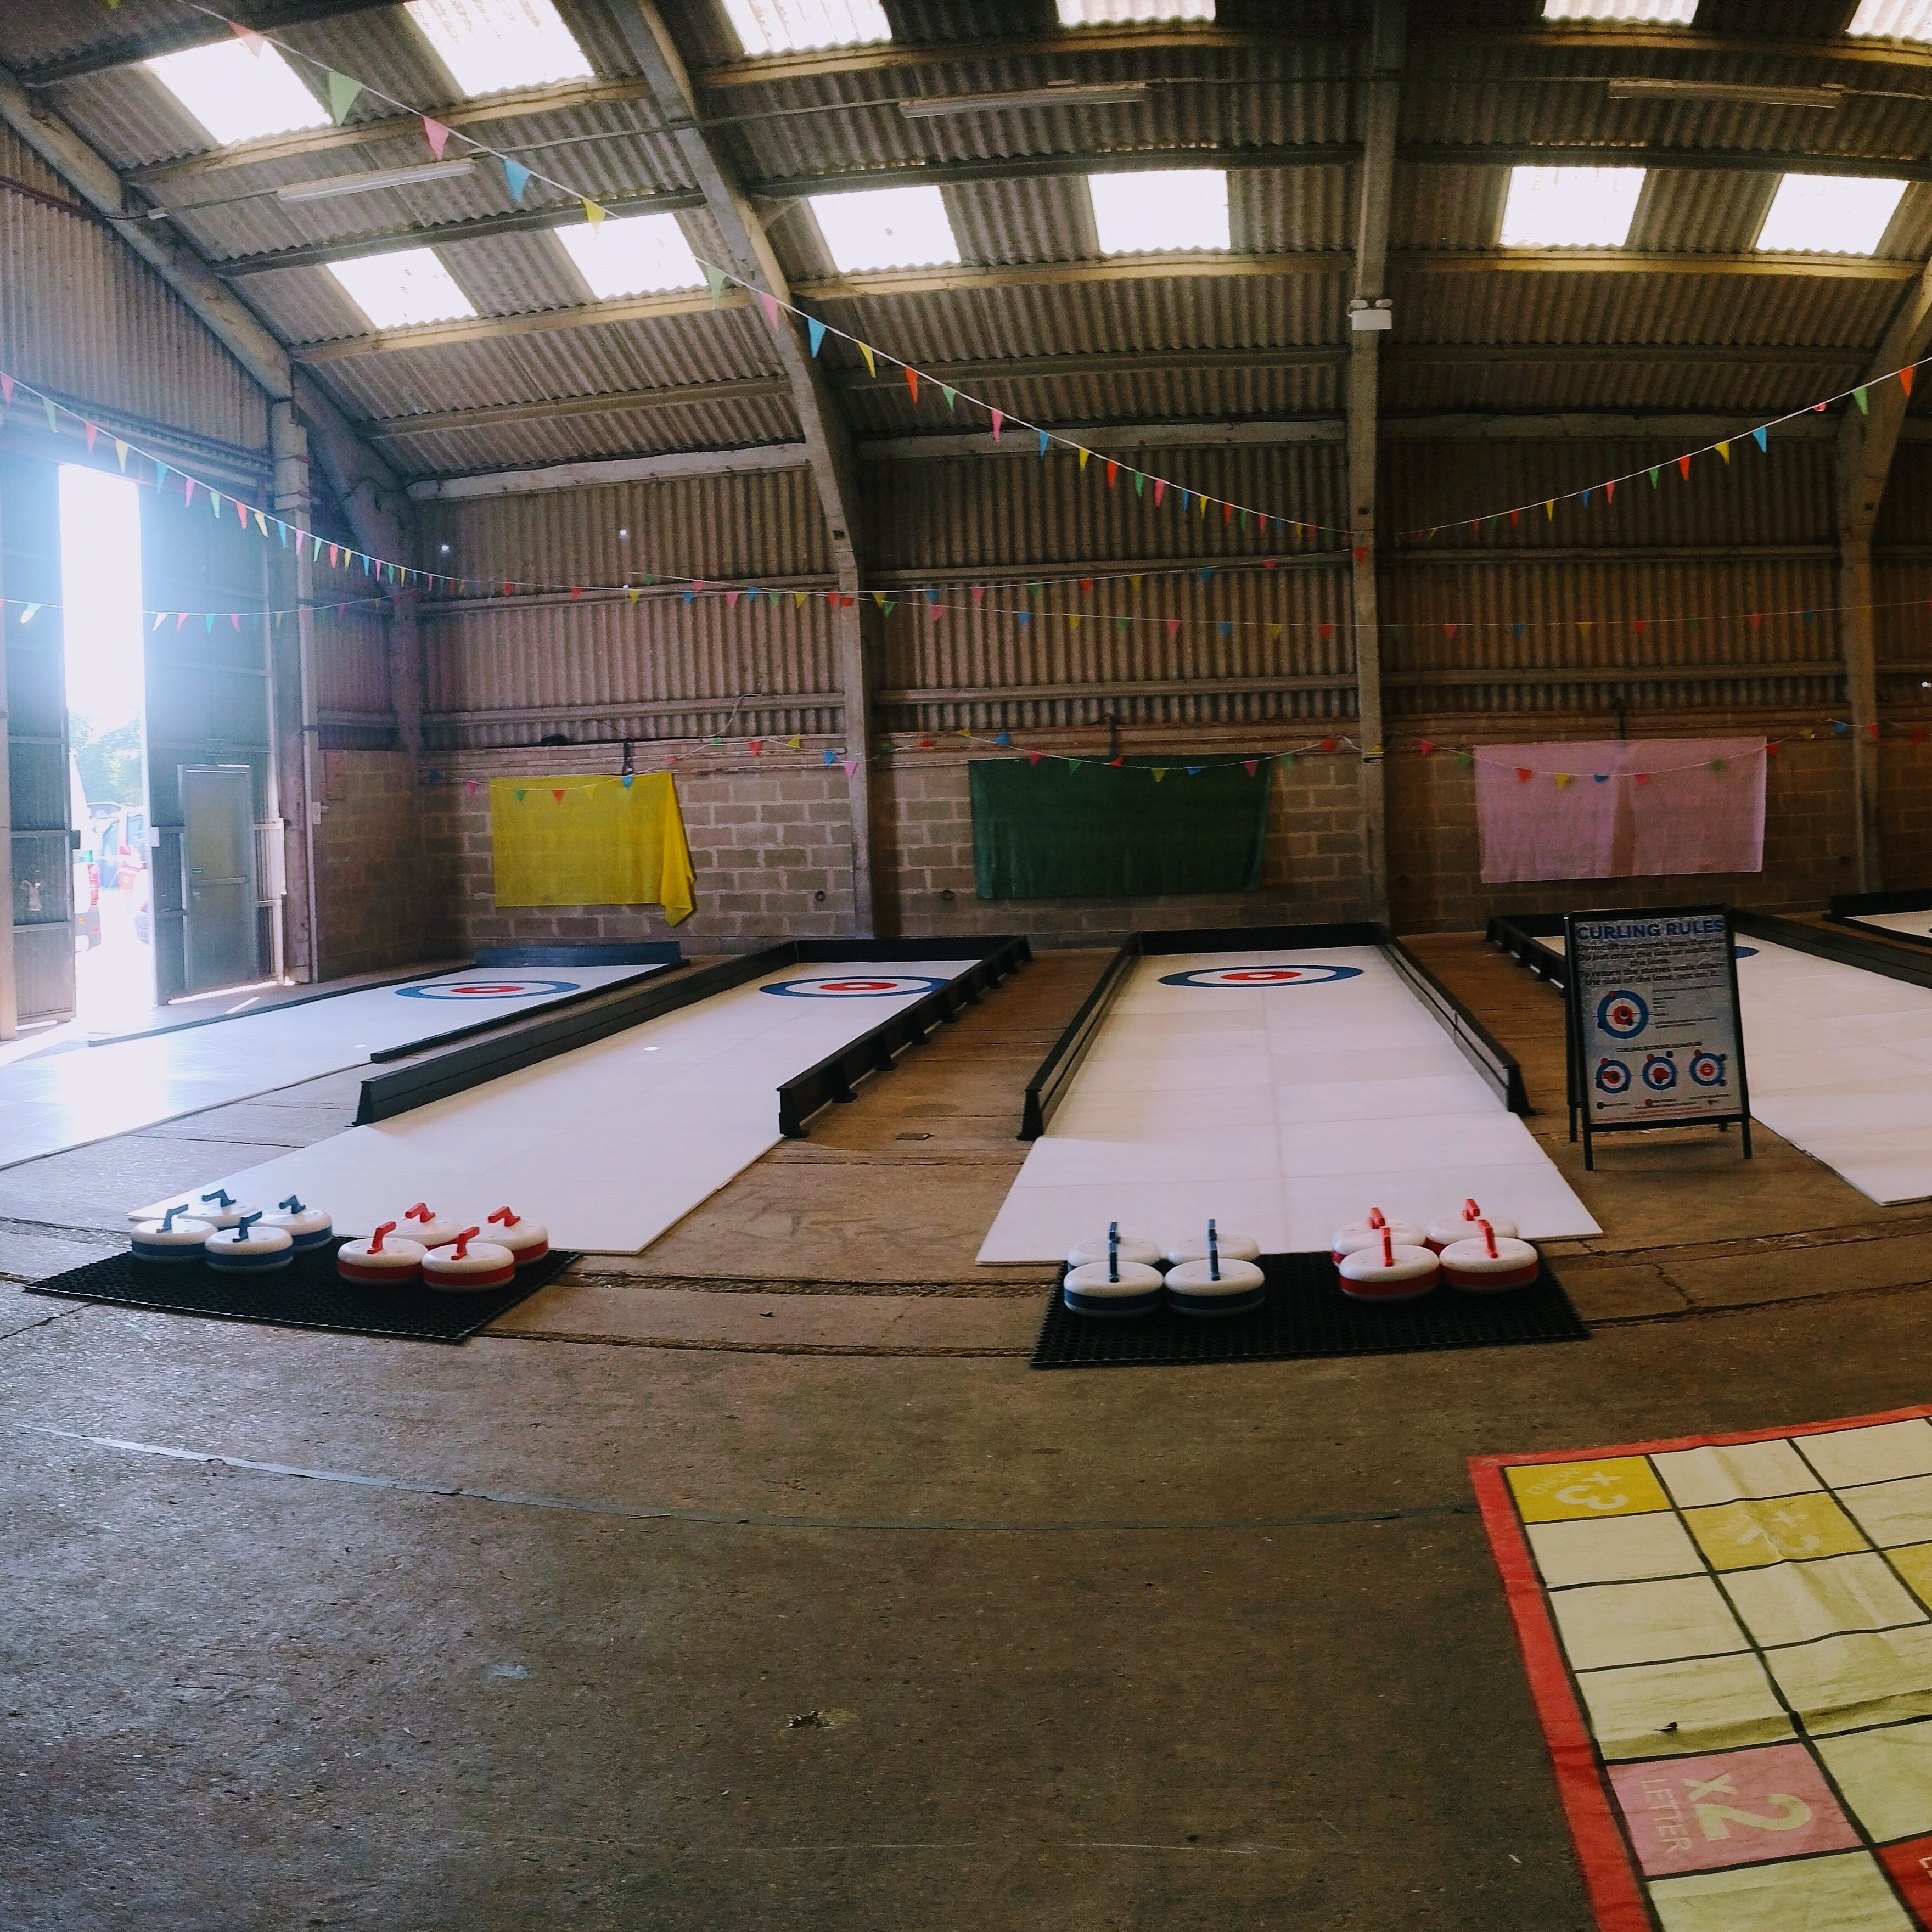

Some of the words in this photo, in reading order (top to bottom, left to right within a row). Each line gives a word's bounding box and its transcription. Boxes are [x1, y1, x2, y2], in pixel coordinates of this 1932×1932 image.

[1577, 923, 1660, 940] CURLING
[1666, 920, 1725, 935] RULES
[1641, 1778, 1693, 1853] LETTER
[1681, 1772, 1812, 1841] x2
